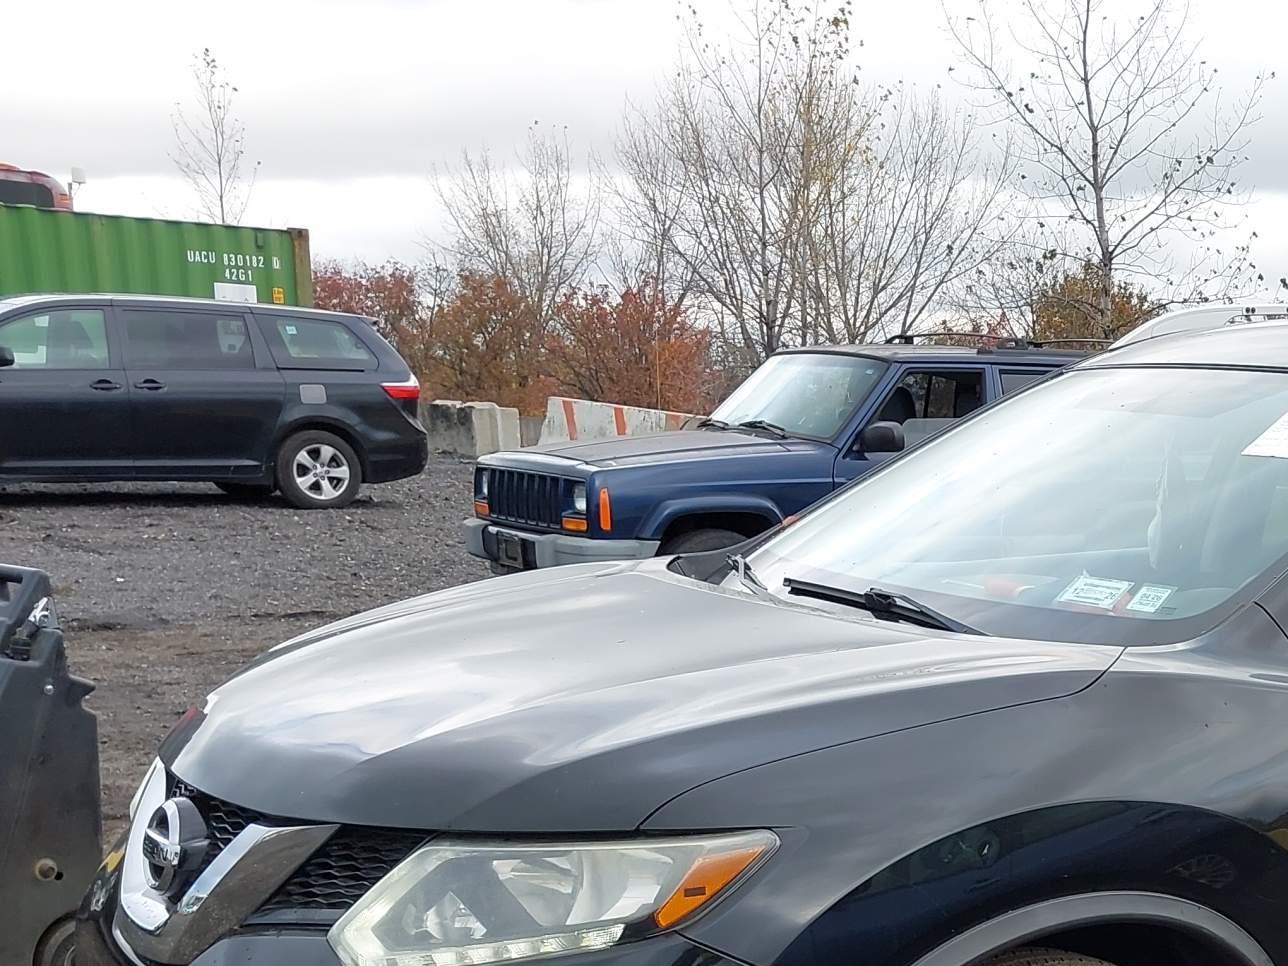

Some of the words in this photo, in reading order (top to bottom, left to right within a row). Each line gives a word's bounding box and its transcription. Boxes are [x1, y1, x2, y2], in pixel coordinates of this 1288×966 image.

[187, 249, 216, 264] UACU
[223, 253, 264, 267] 830182
[225, 268, 252, 281] 42G1
